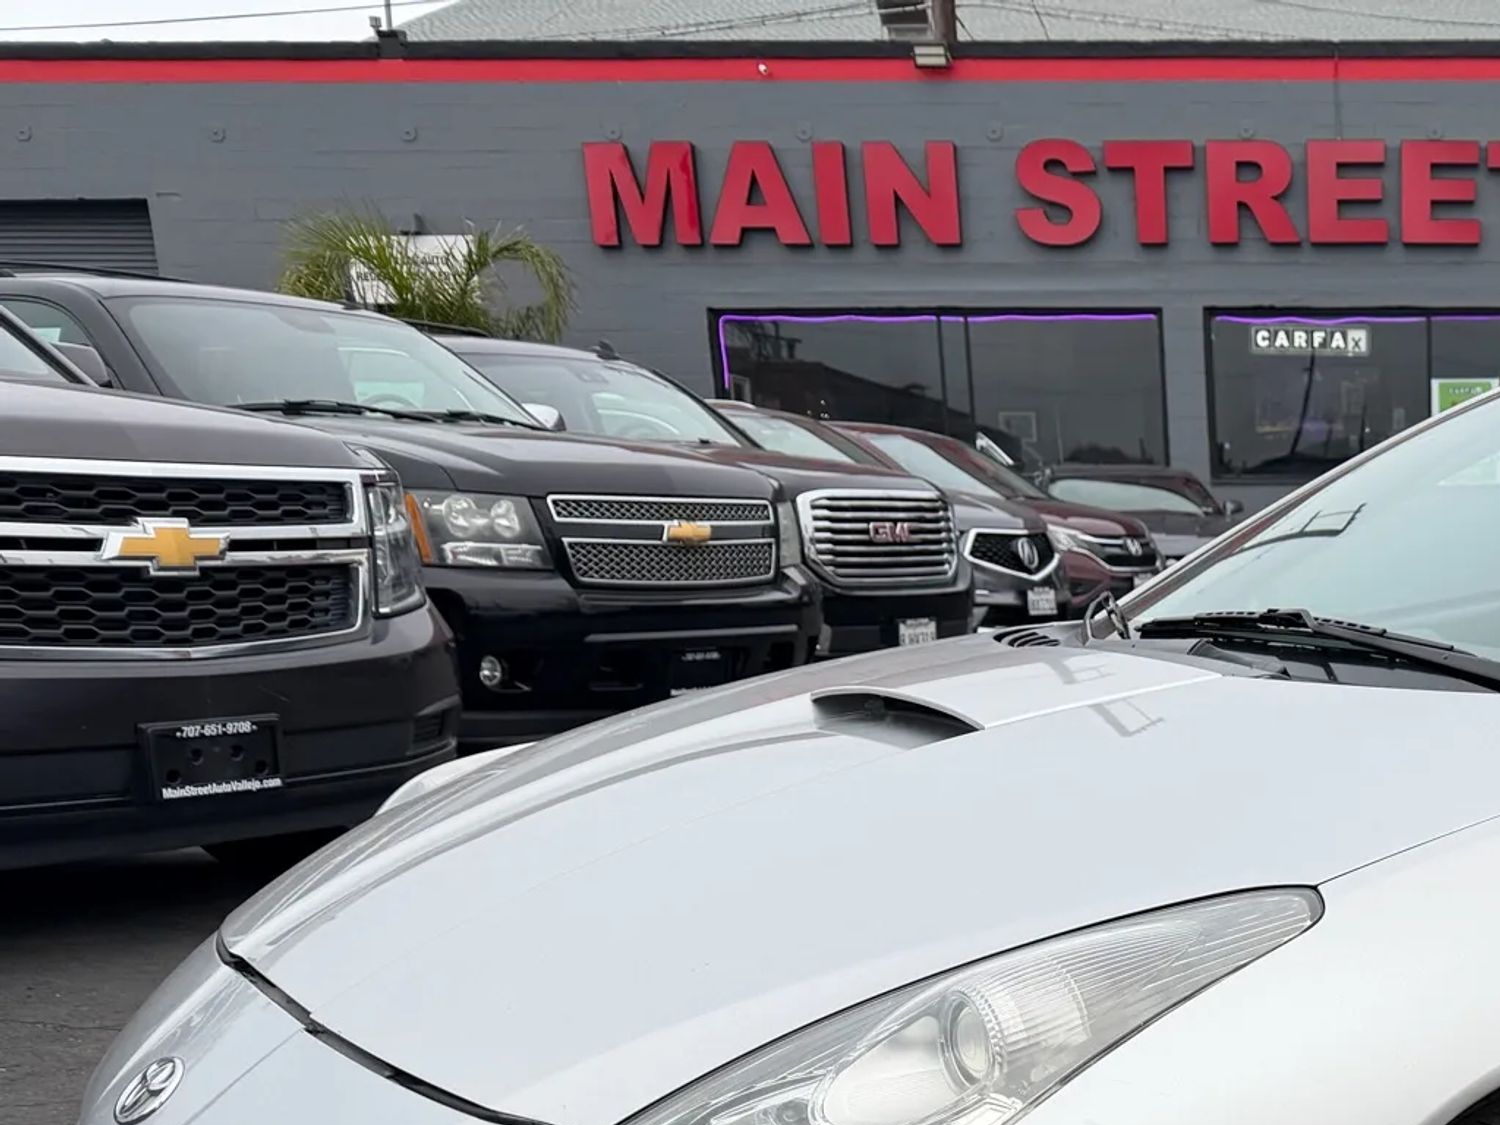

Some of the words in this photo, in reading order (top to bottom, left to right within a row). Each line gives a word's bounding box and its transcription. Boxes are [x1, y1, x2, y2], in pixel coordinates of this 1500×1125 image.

[584, 140, 961, 247] MAIN
[1255, 330, 1363, 352] CARFAX
[162, 778, 282, 799] MainStreetAutoVallejo.com
